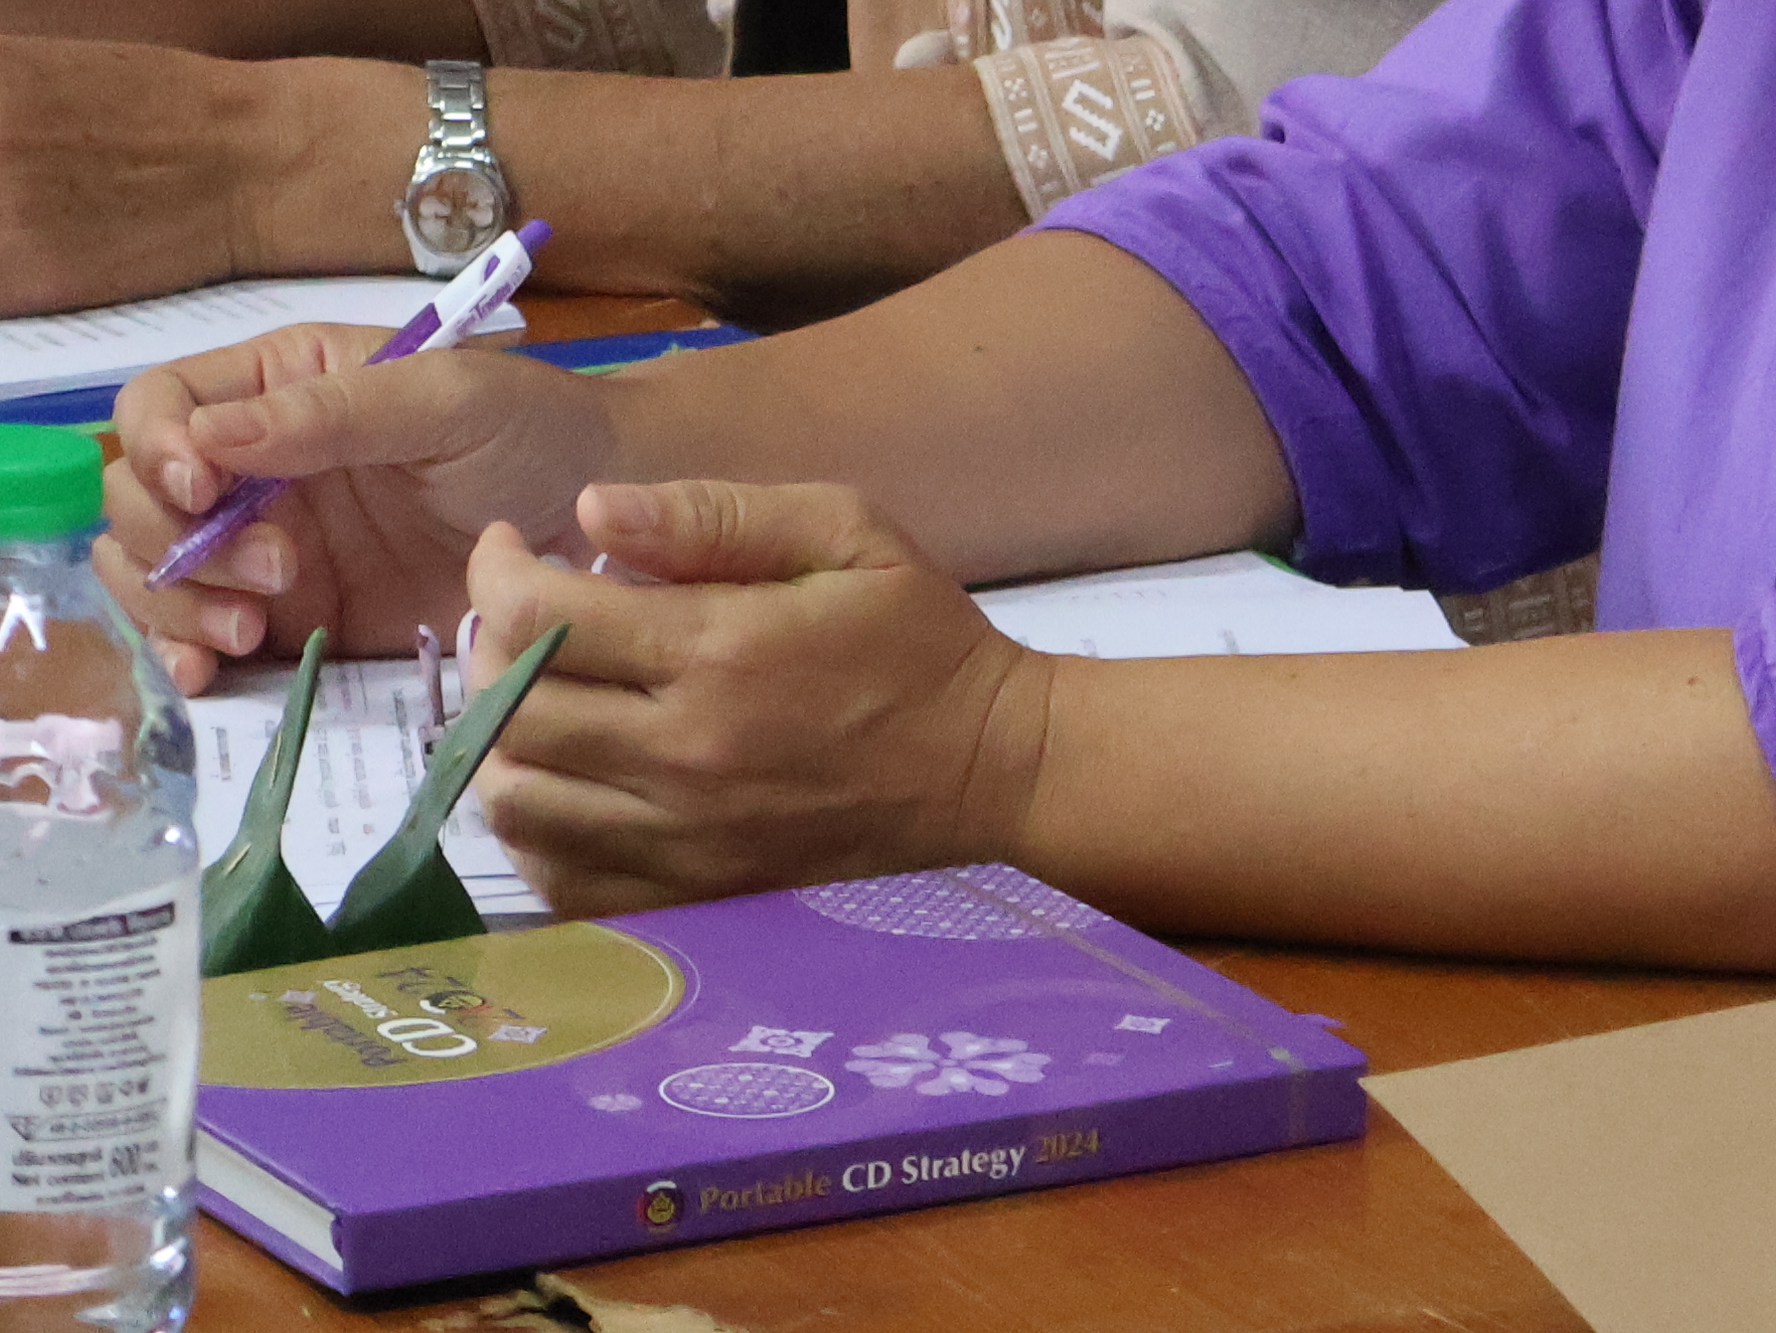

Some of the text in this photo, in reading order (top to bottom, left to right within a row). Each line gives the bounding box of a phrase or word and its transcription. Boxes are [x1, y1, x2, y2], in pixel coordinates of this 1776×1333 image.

[376, 1018, 478, 1058] CD
[699, 1129, 1100, 1214] Portable CD Strategy 2024
